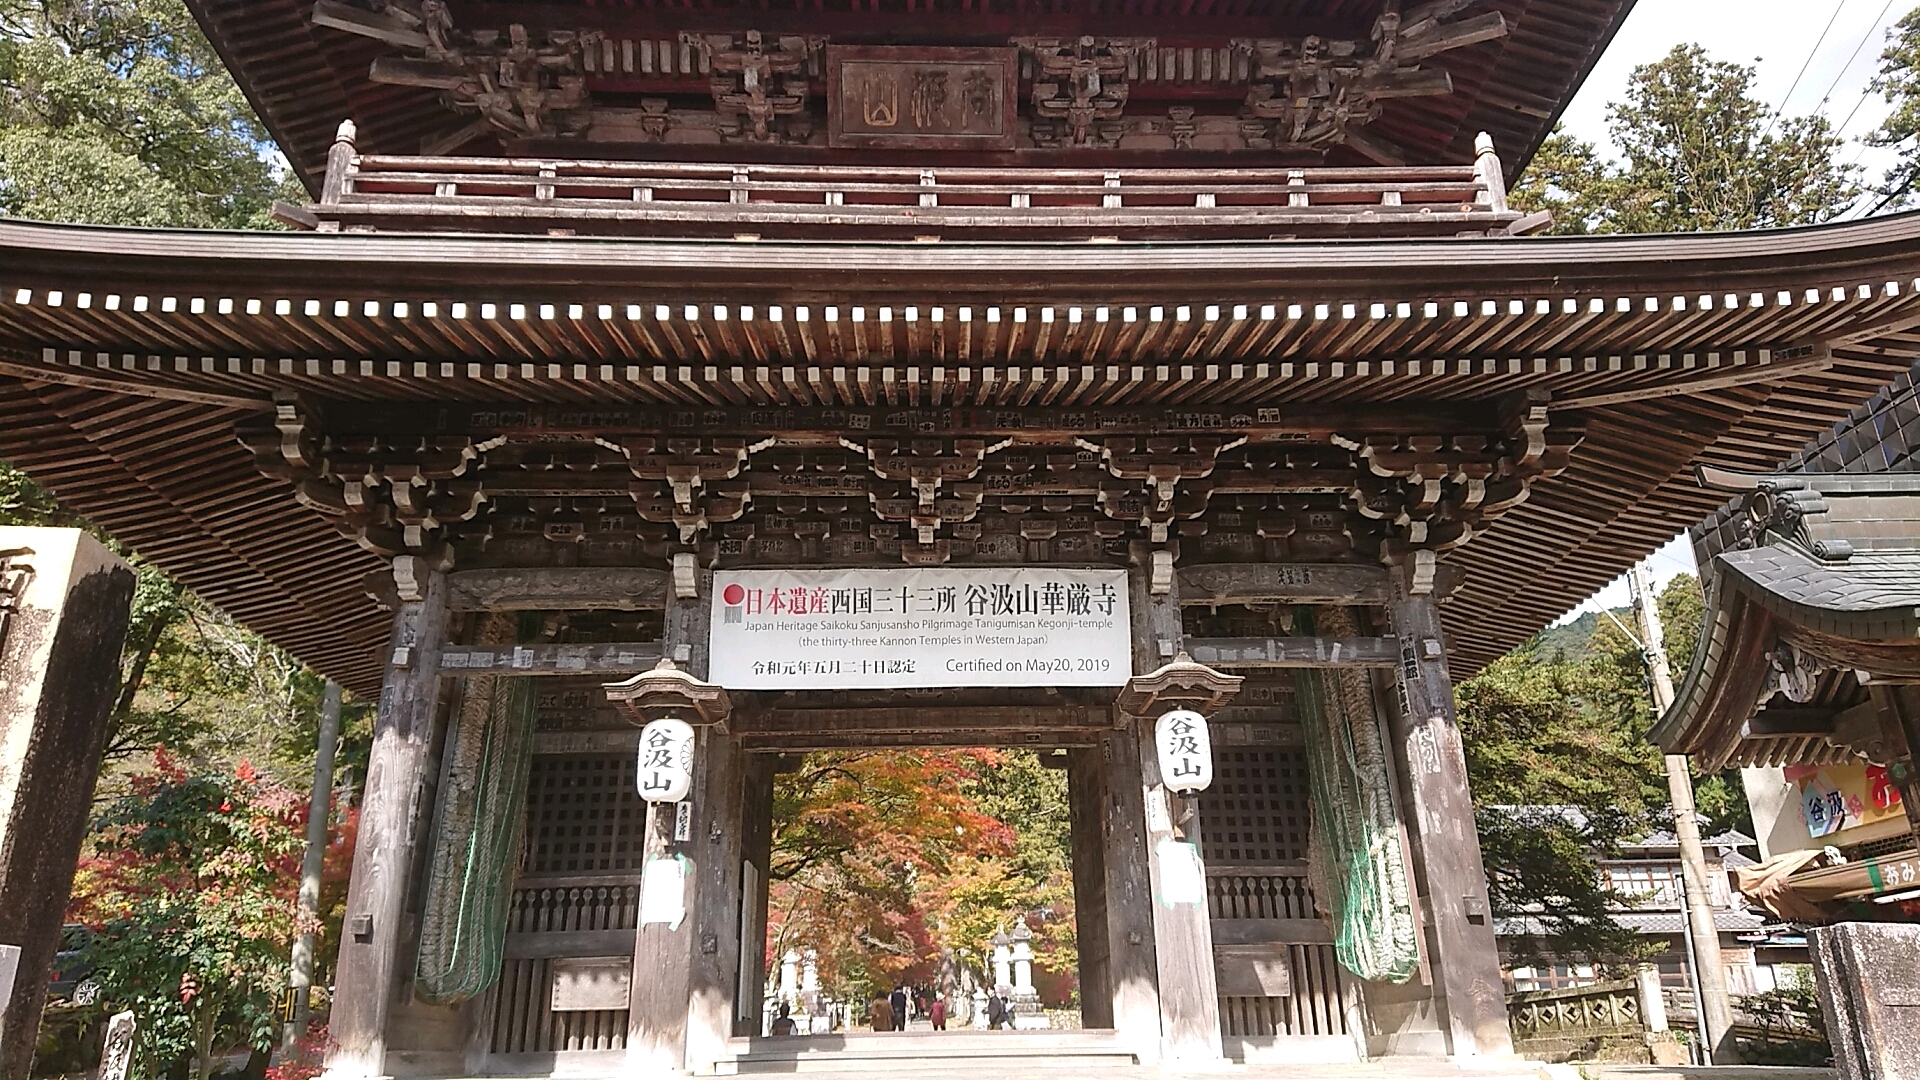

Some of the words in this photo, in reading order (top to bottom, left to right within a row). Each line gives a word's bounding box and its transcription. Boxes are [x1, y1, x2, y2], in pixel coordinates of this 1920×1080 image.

[746, 586, 957, 615] 日本遺産西国三十三所
[964, 582, 1117, 616] 谷汲山華厳寺
[745, 621, 774, 633] Japan
[776, 621, 818, 632] Heritage
[820, 621, 858, 631] Saikoku
[860, 620, 920, 632] Sanjusansho
[922, 619, 973, 631] Pilgrimage
[975, 618, 1035, 631] Tanigumisan
[1038, 618, 1113, 631] Kegonji-temple
[798, 636, 819, 647] (the
[821, 636, 878, 648] thirty-three
[880, 636, 917, 646] Kannon
[919, 635, 961, 647] Temples
[963, 635, 973, 645] in
[975, 635, 1015, 645] Western
[1016, 633, 1049, 647] Japan)
[751, 659, 916, 675] 令和元年五月二十日認定
[946, 658, 1002, 672] Certified
[1006, 662, 1022, 672] on
[1026, 658, 1074, 674] May20,
[1077, 658, 1110, 672] 2019
[1168, 717, 1201, 778] 谷汲山
[643, 728, 676, 792] 谷汲山
[1884, 861, 1920, 885] おみ
